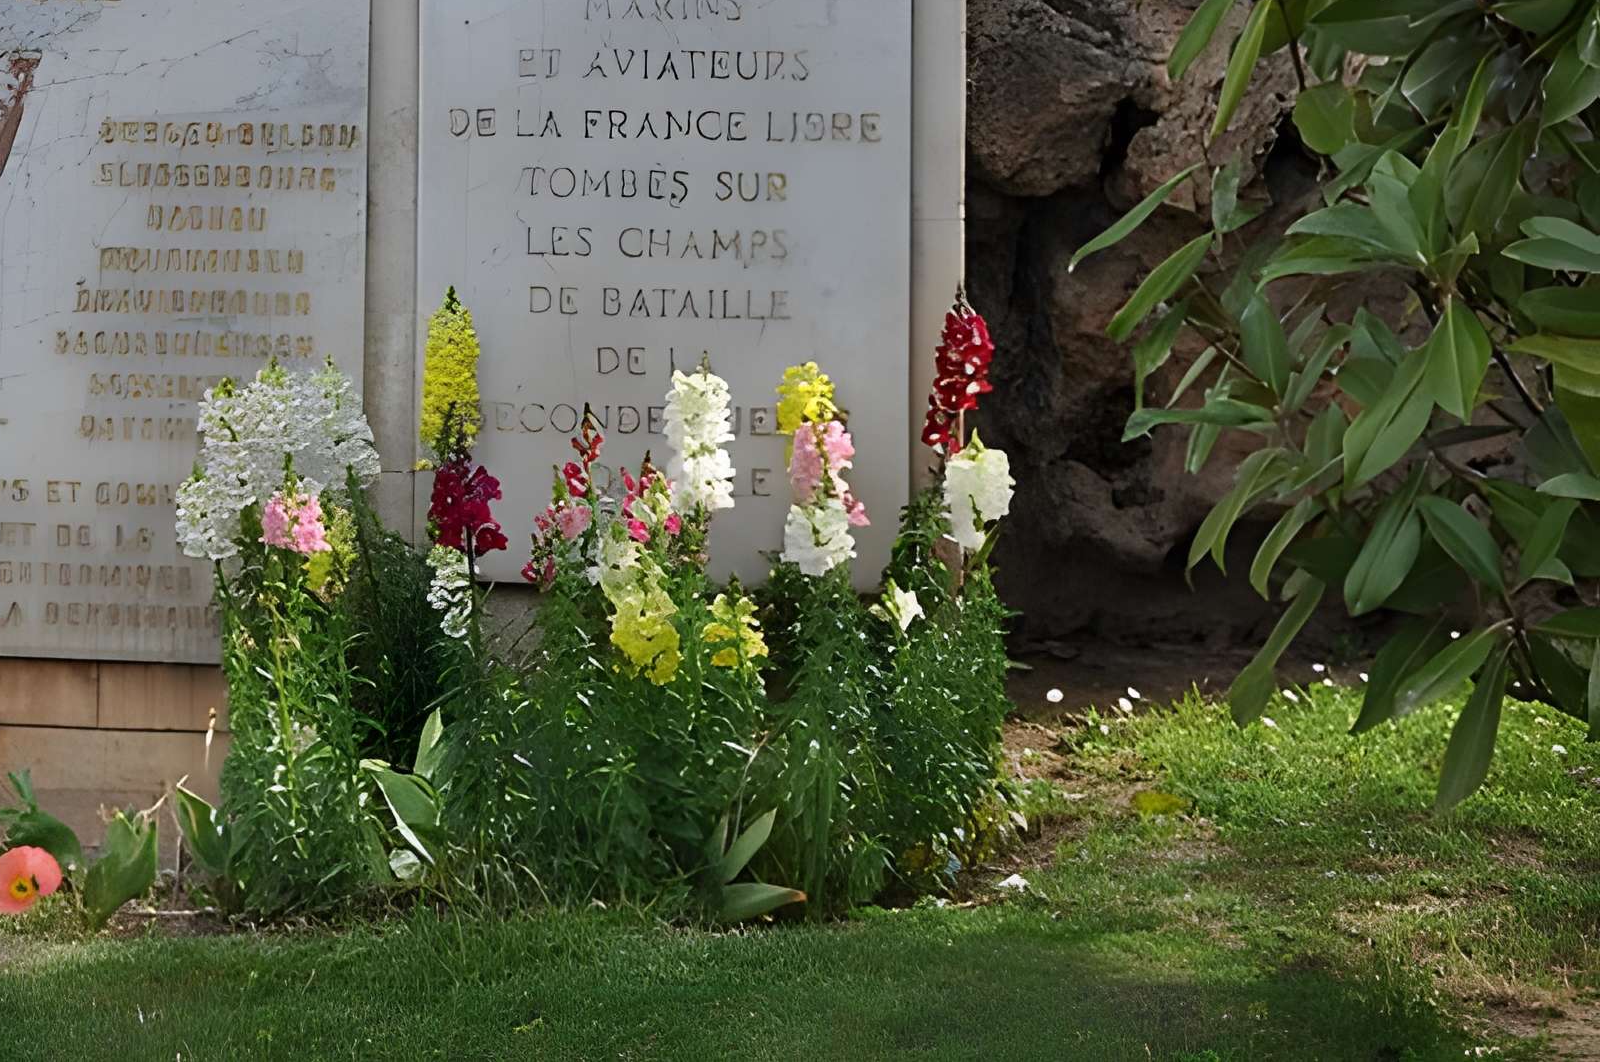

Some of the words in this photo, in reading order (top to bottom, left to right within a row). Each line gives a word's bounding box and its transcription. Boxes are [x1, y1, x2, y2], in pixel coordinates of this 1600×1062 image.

[582, 49, 810, 81] AVIATEURS
[449, 108, 496, 137] DE
[516, 110, 562, 139] LA
[584, 110, 748, 141] FRANCE
[766, 112, 882, 143] LIBRE
[715, 172, 787, 202] SUR
[527, 226, 593, 256] LES
[618, 227, 788, 259] CHAMPS
[529, 286, 578, 314] DE
[603, 287, 790, 320] BATAILLE
[597, 346, 646, 375] DE
[480, 402, 664, 435] ECONDE
